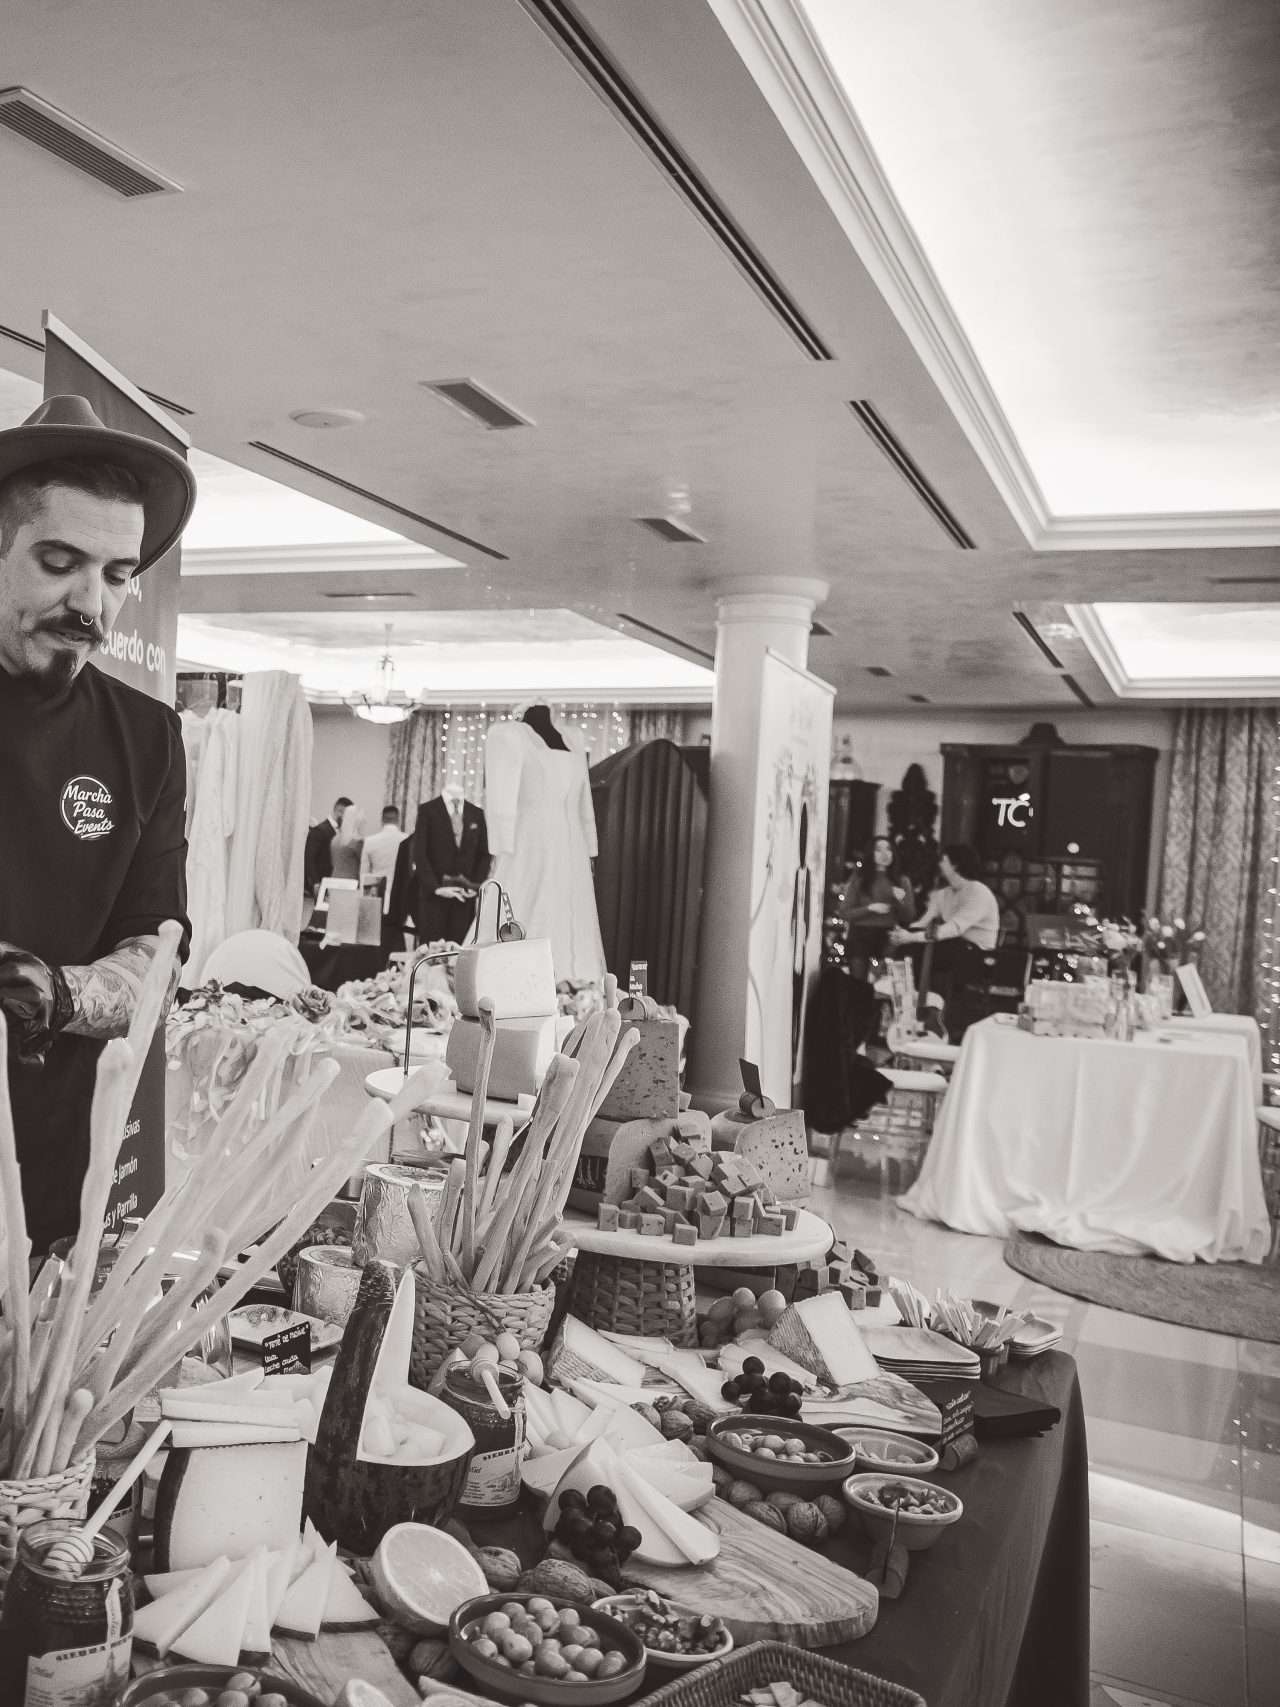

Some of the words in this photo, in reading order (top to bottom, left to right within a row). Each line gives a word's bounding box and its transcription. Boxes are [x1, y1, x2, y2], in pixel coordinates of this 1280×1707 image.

[146, 643, 166, 674] con
[63, 784, 113, 804] Marcha
[72, 801, 106, 818] Pasa
[74, 817, 116, 835] Events
[118, 1155, 138, 1185] Jamón
